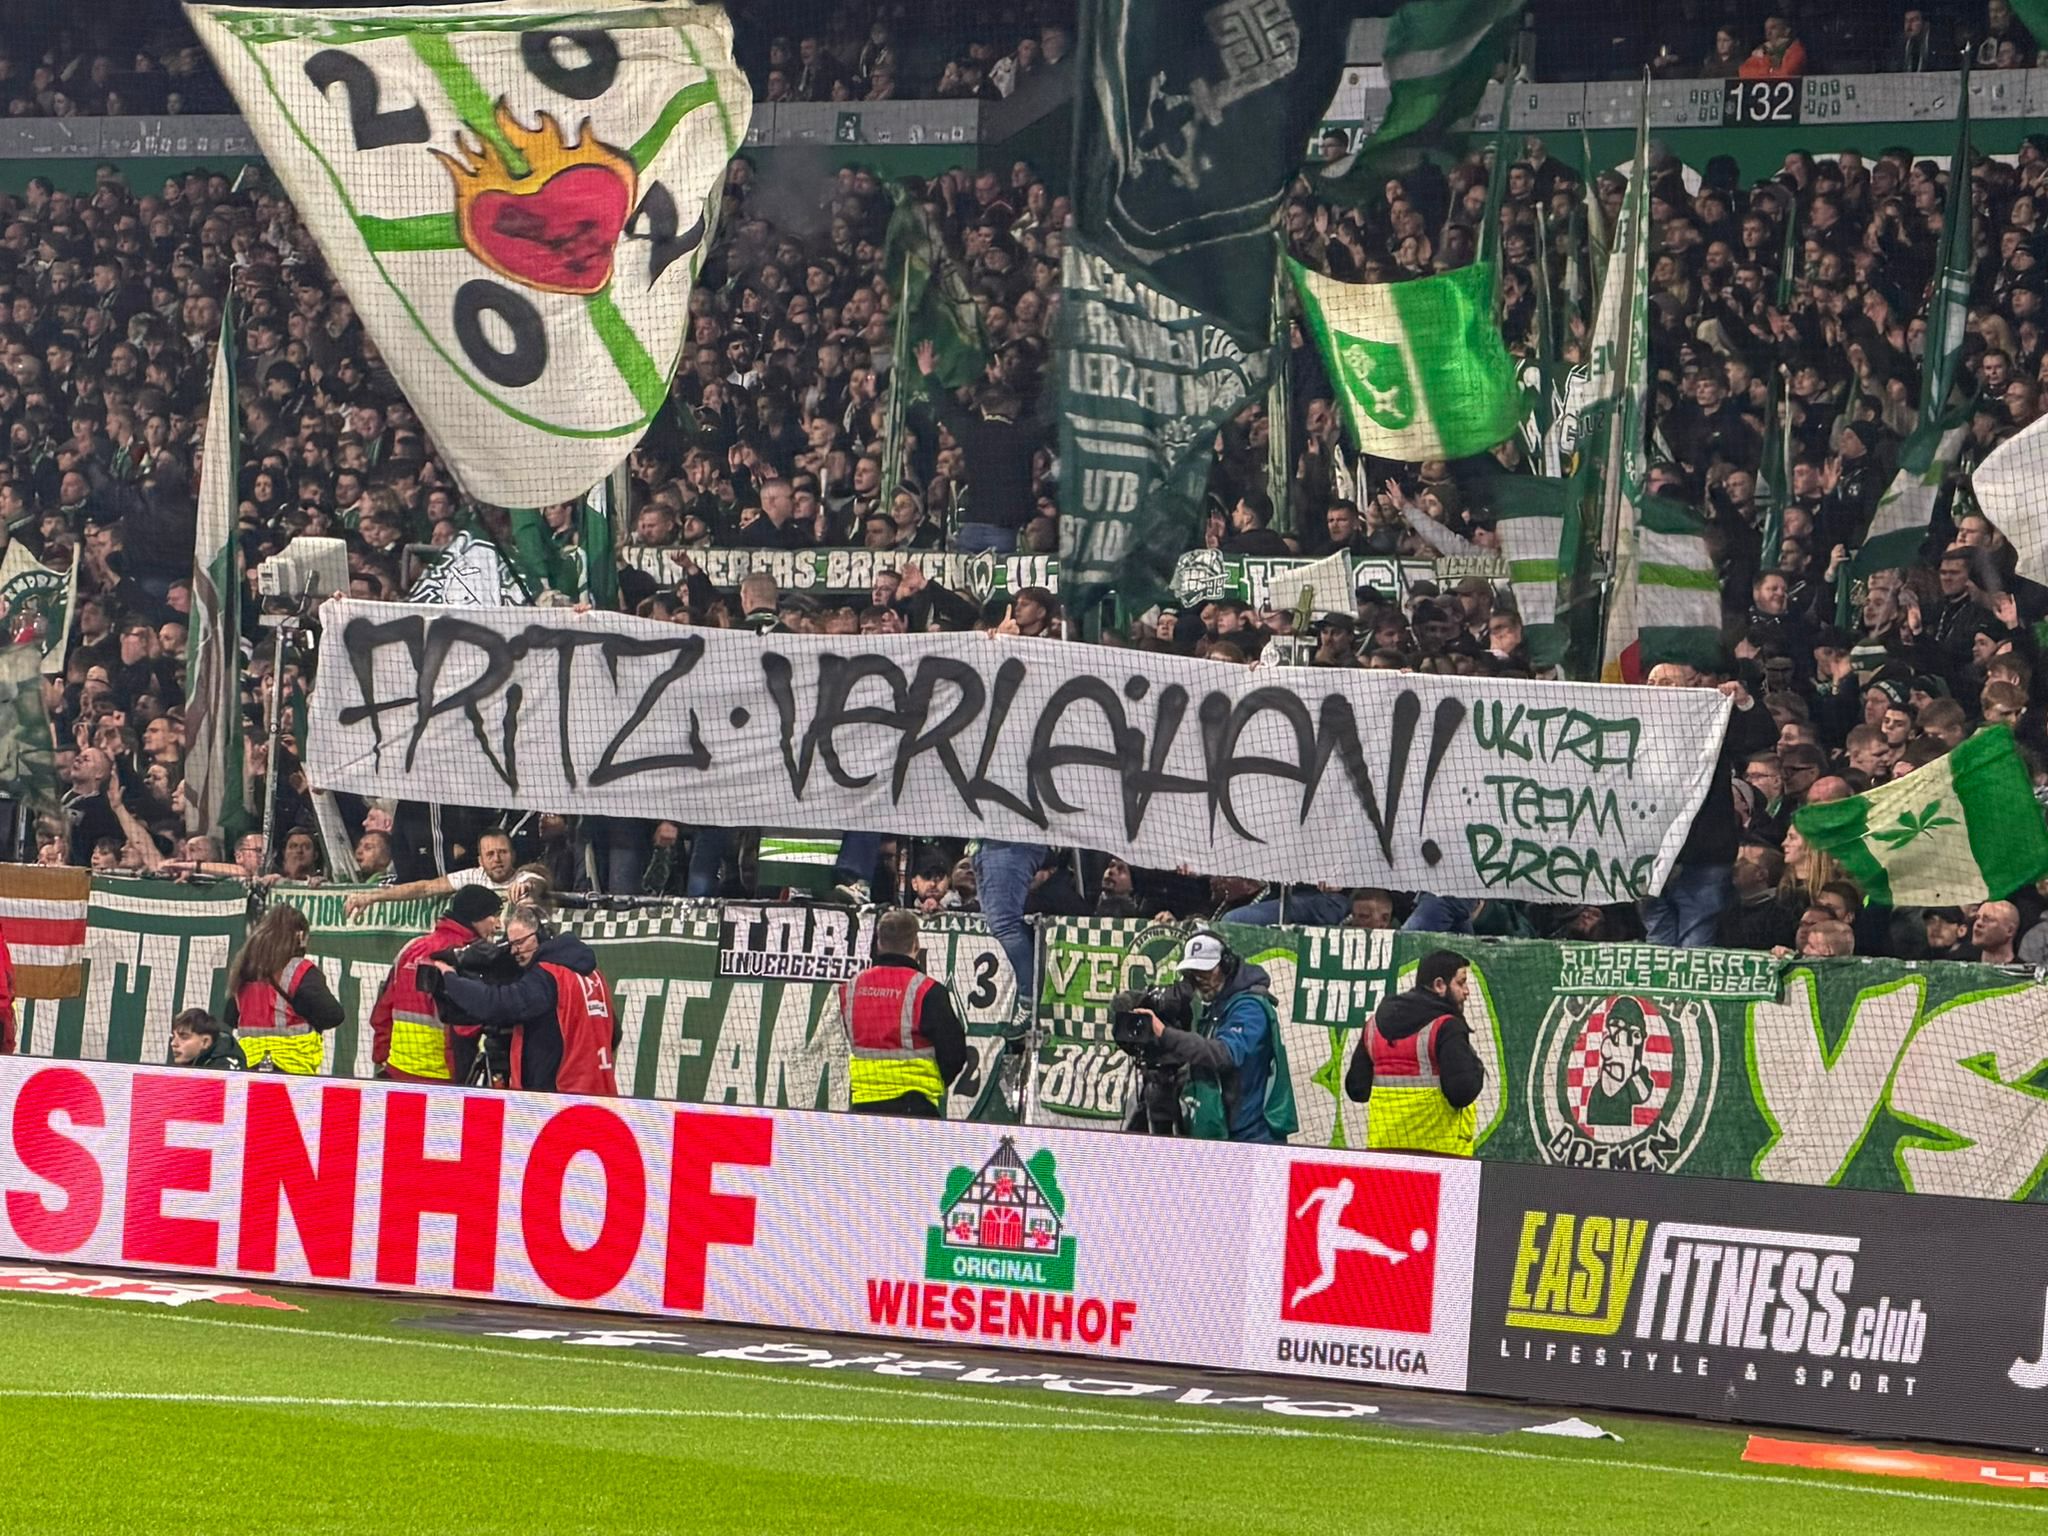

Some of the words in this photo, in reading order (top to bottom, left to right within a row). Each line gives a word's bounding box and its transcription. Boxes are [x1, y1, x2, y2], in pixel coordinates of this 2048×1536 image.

[1730, 81, 1794, 122] 132
[453, 278, 548, 388] 0
[1483, 775, 1628, 849] TEAM
[721, 951, 872, 979] UNVERGESSEN
[1191, 941, 1203, 957] P
[857, 986, 902, 999] SECURITY
[967, 952, 999, 1011] 3
[1560, 970, 1651, 988] NIEMALS
[1547, 1122, 1681, 1172] BREMEN
[5, 1067, 774, 1311] SENHOF
[953, 1256, 1047, 1284] ORIGINAL
[866, 1279, 1138, 1347] WIESENHOF
[1277, 1336, 1429, 1375] BUNDESLIGA
[1500, 1337, 1709, 1376] LIFESTYLE
[1745, 1361, 1757, 1381] &
[1795, 1365, 1917, 1396] SPORT
